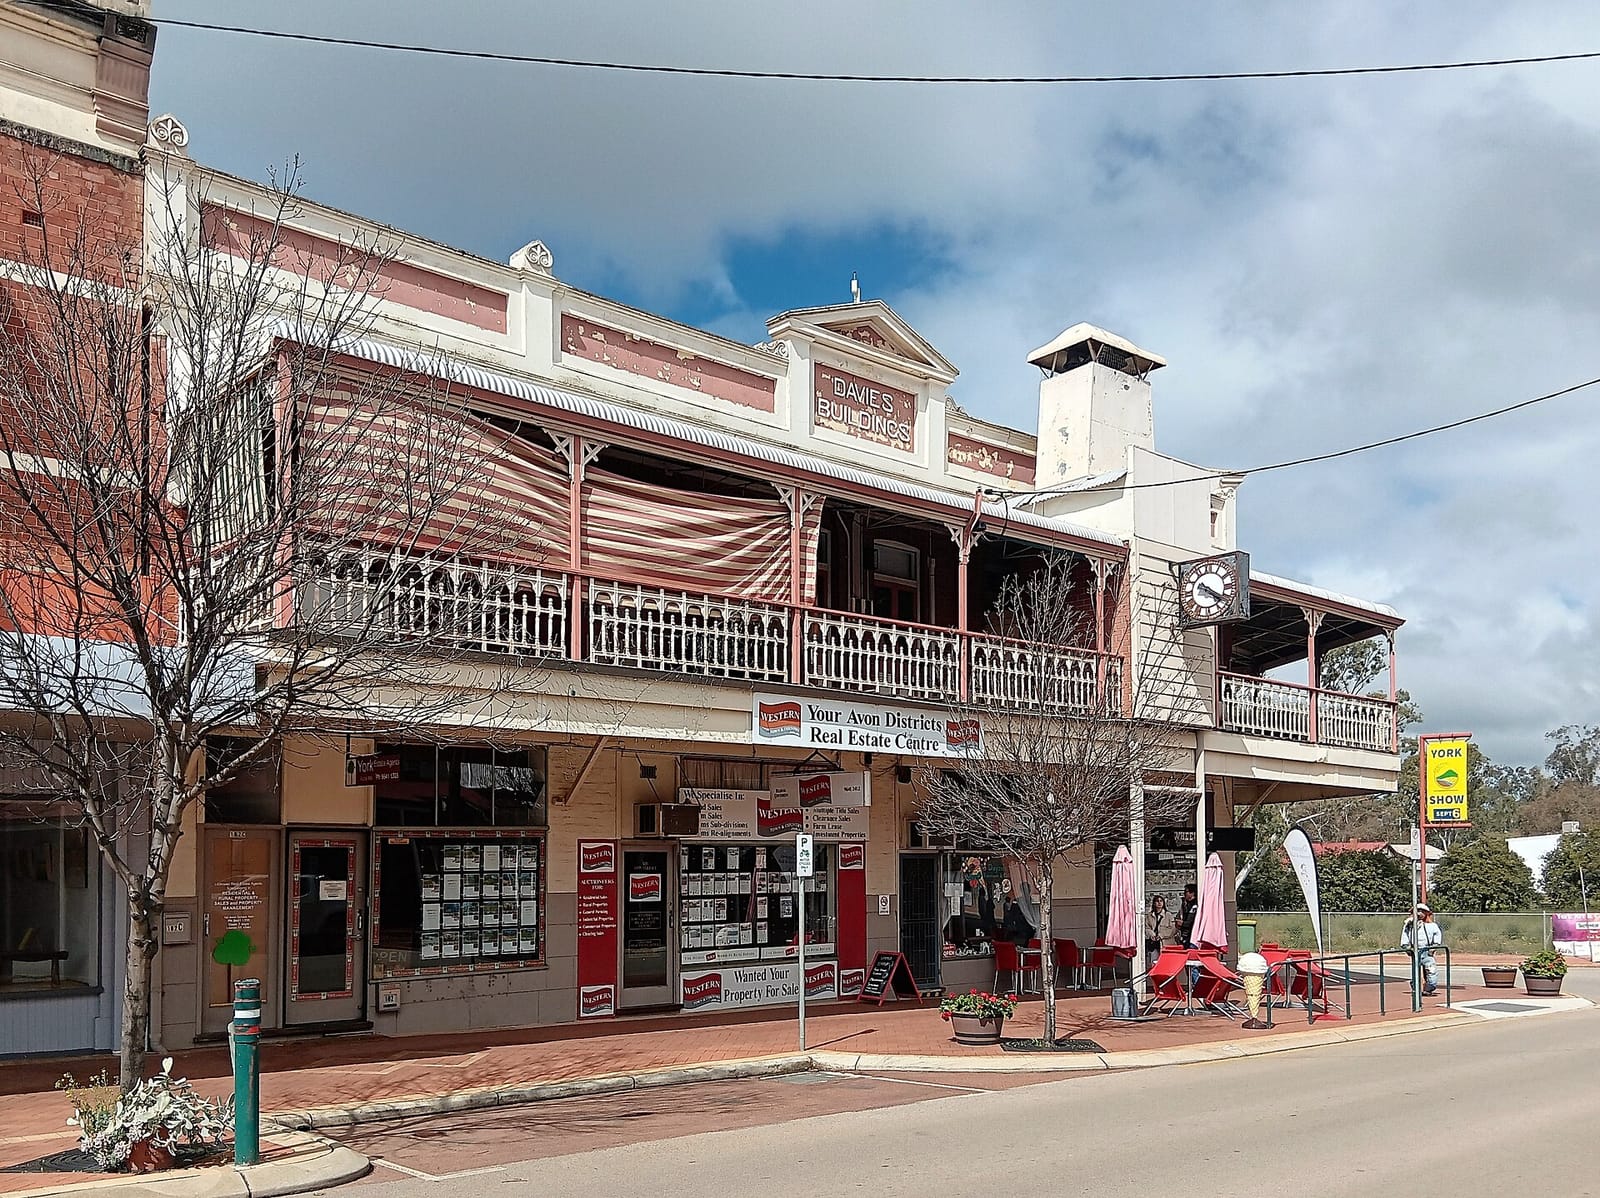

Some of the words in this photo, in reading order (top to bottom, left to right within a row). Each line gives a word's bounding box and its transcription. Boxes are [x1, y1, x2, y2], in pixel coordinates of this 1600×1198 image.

[833, 376, 894, 413] DAVIES
[817, 397, 911, 442] BUILDINGS
[760, 708, 801, 722] WESTERN
[807, 704, 842, 723] Your
[847, 709, 880, 727] Avon
[886, 711, 942, 732] Districts
[810, 726, 843, 745] Real
[848, 730, 892, 749] Estate
[894, 732, 940, 752] Centre
[1431, 748, 1462, 758] YORK
[357, 759, 374, 773] York
[800, 781, 830, 794] WESTERN
[697, 791, 733, 801] Specialise
[735, 792, 745, 800] In:
[1429, 795, 1465, 805] SHOW
[707, 803, 722, 811] Sales
[707, 812, 723, 820] Sales
[758, 808, 803, 819] WESTERN
[812, 814, 838, 822] Clearance
[1452, 809, 1460, 818] 6
[710, 820, 748, 829] Sub-divisions
[710, 829, 751, 838] Re-alignments
[801, 837, 808, 847] P
[583, 849, 612, 860] WESTERN
[840, 850, 862, 860] WESTERN
[631, 879, 659, 889] WESTERN
[734, 968, 767, 983] Wanted
[769, 967, 790, 981] Your
[842, 975, 863, 985] WESTERN
[684, 980, 721, 995] WESTERN
[724, 987, 763, 1004] Property
[766, 984, 780, 997] For
[782, 983, 800, 996] Sale
[583, 993, 612, 1005] WESTERN
